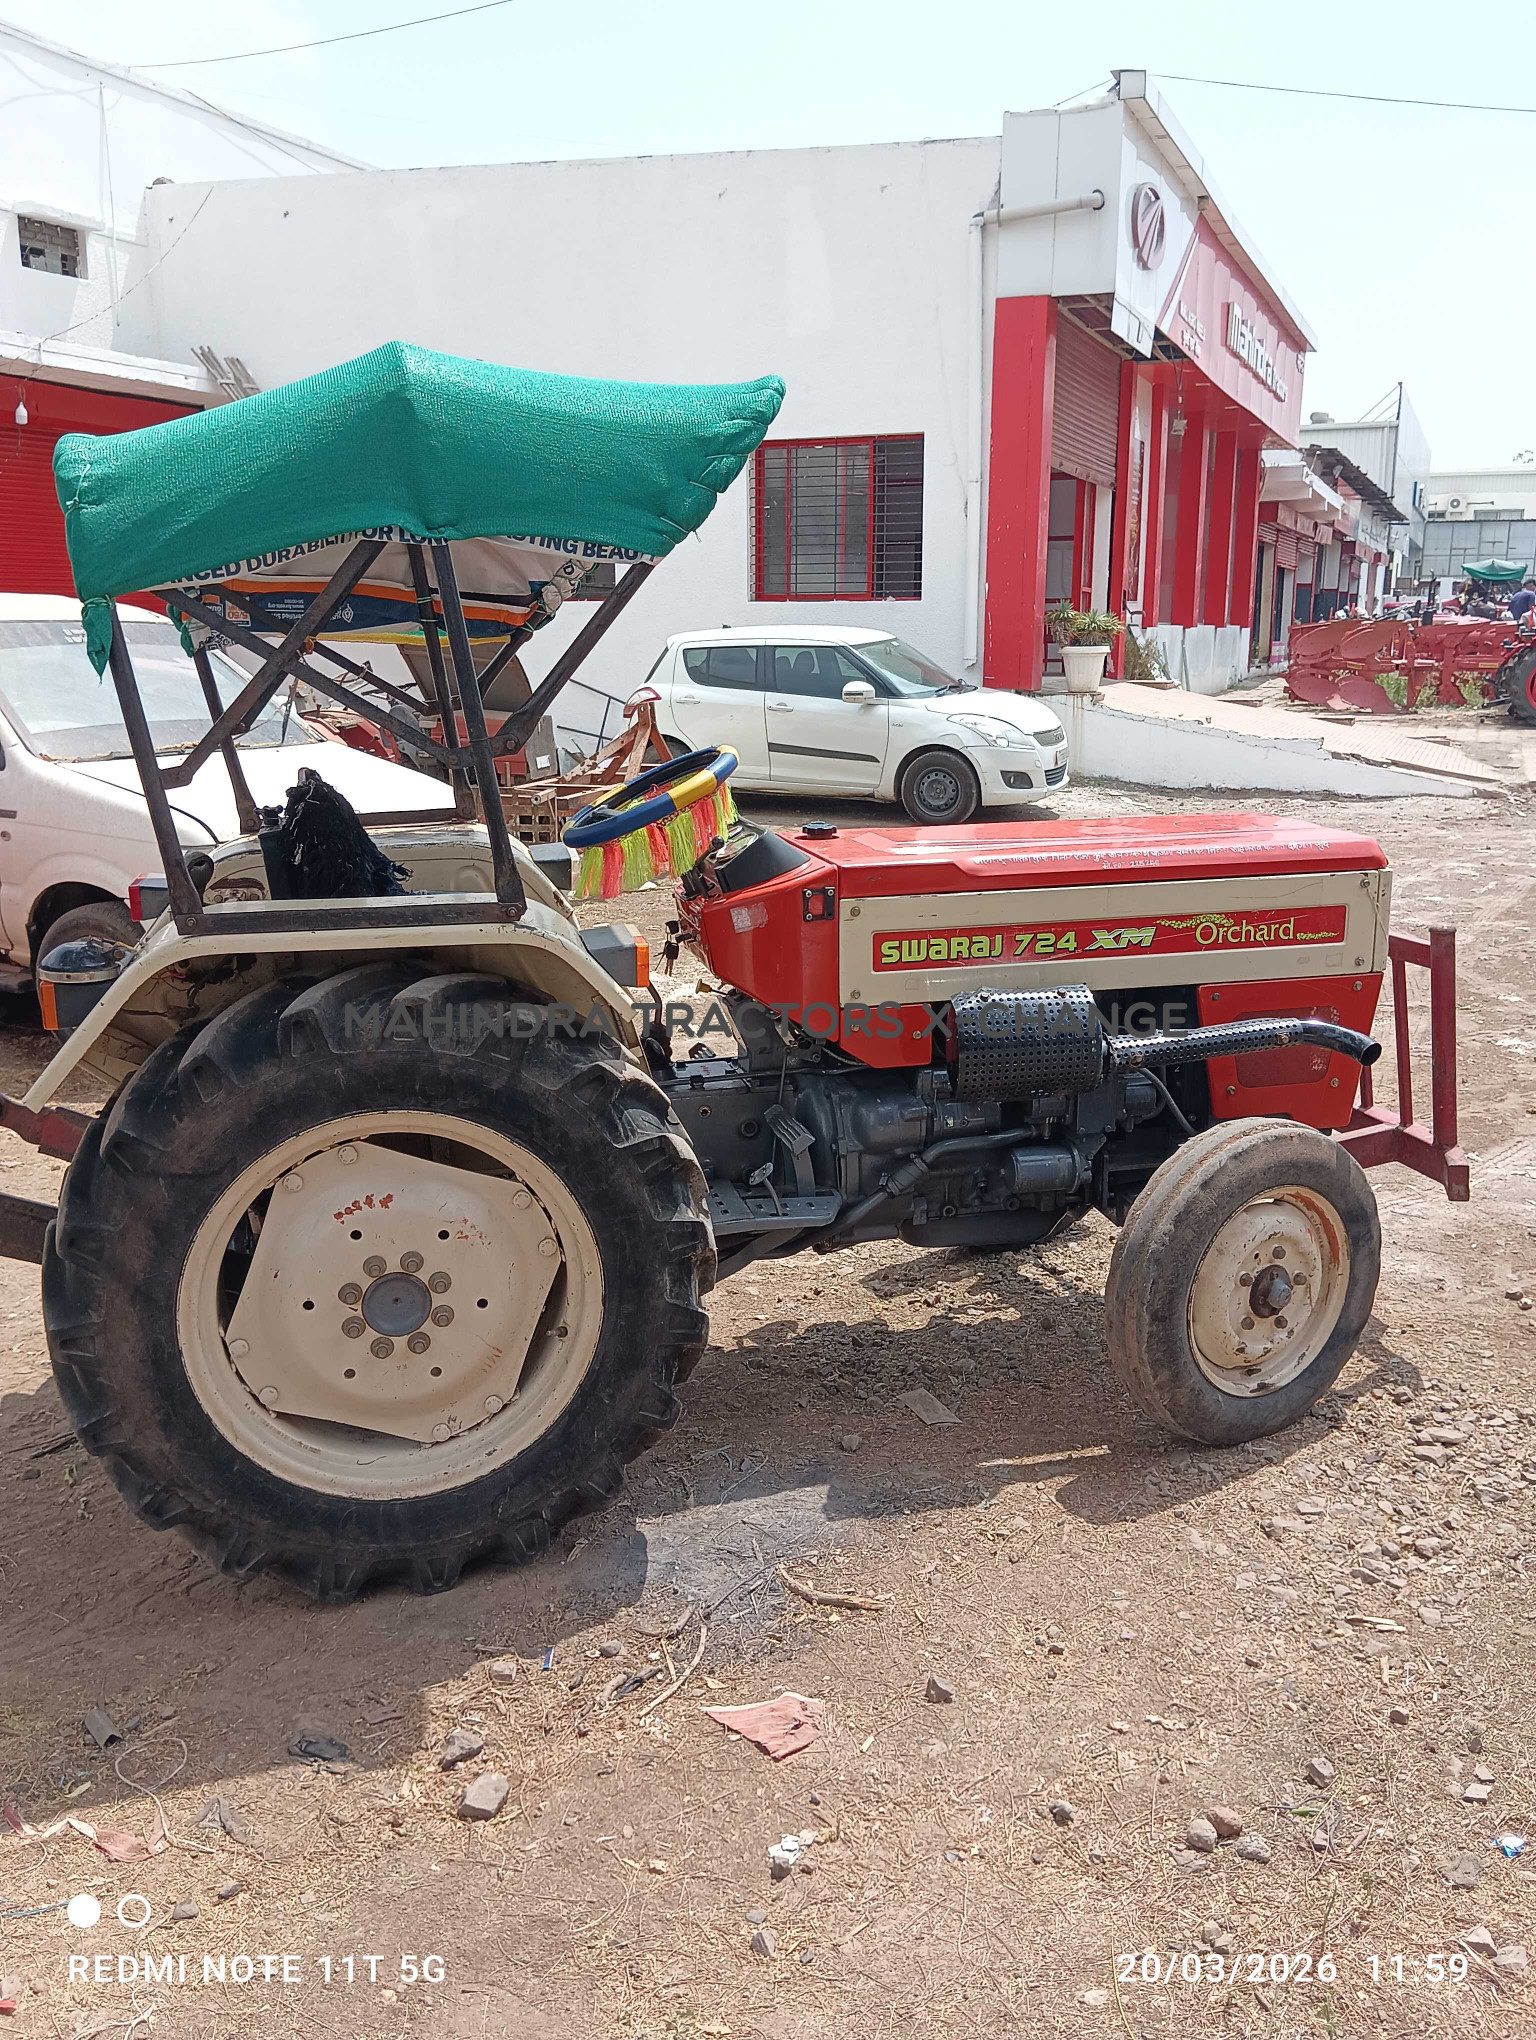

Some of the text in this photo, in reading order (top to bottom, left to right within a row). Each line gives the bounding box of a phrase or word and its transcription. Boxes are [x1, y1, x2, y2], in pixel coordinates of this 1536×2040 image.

[1013, 931, 1078, 955] 724
[1084, 926, 1156, 950] XM
[1195, 917, 1294, 945] Orchard
